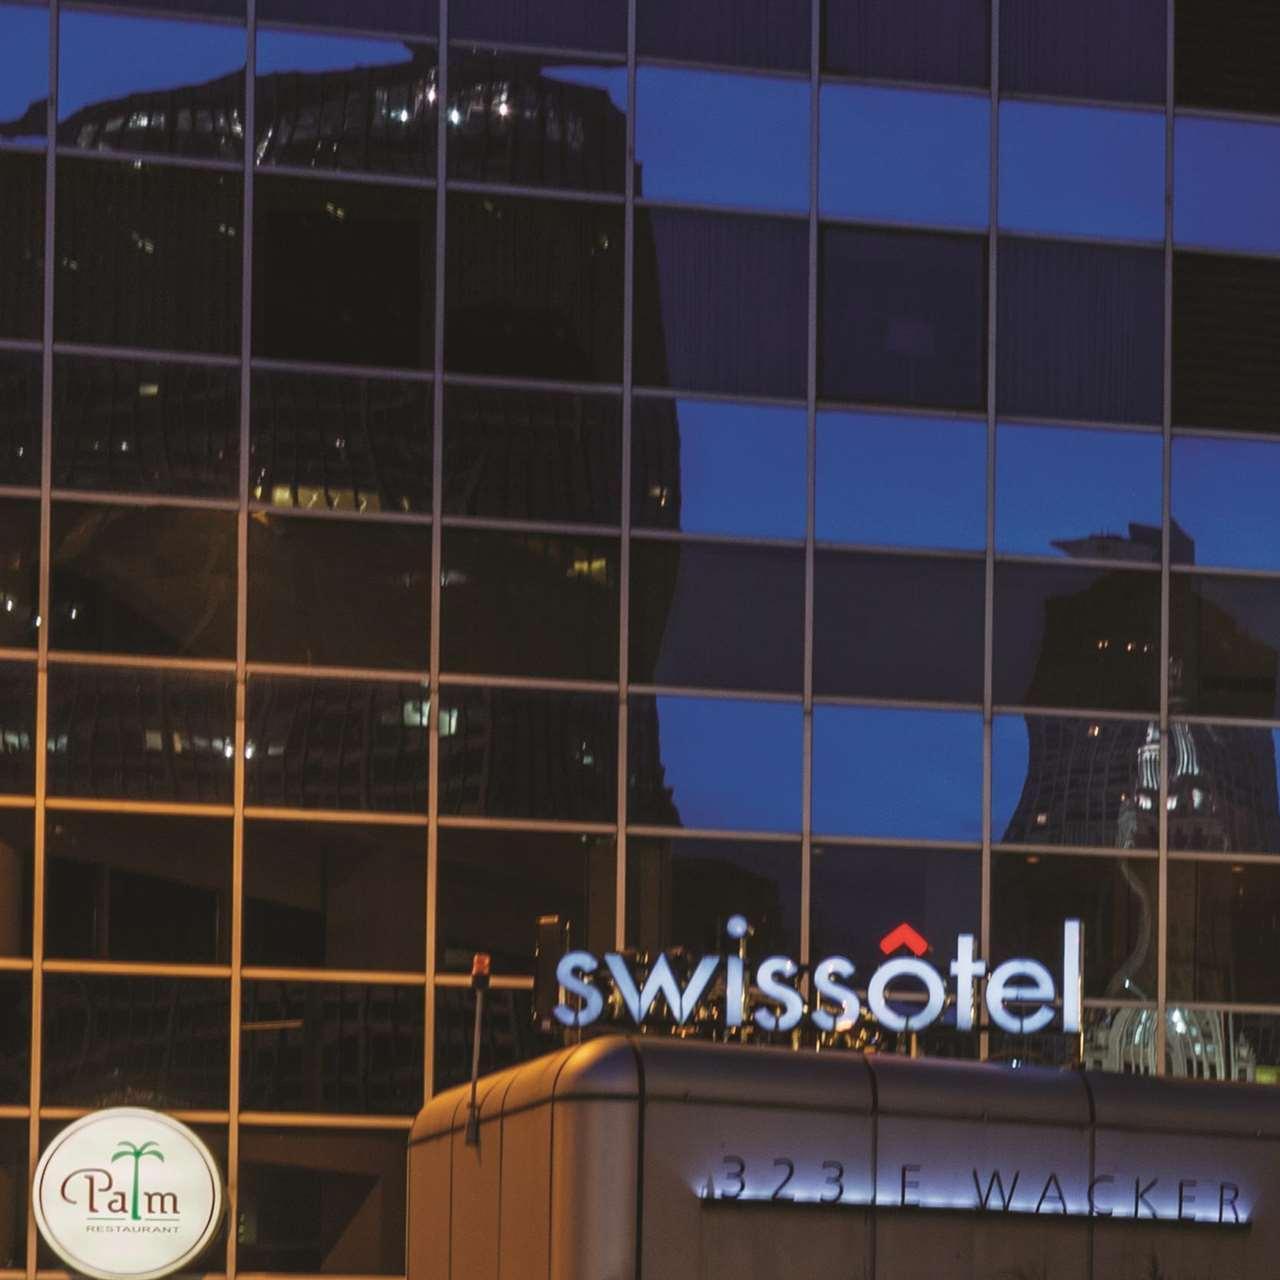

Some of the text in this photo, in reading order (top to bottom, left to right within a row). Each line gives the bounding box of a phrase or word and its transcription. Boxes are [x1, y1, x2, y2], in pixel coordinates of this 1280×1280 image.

[554, 914, 1081, 1034] swissôtel
[60, 1141, 180, 1220] Palm
[720, 1155, 1239, 1223] 323 E WACKER
[86, 1225, 180, 1233] RESTAURANT
